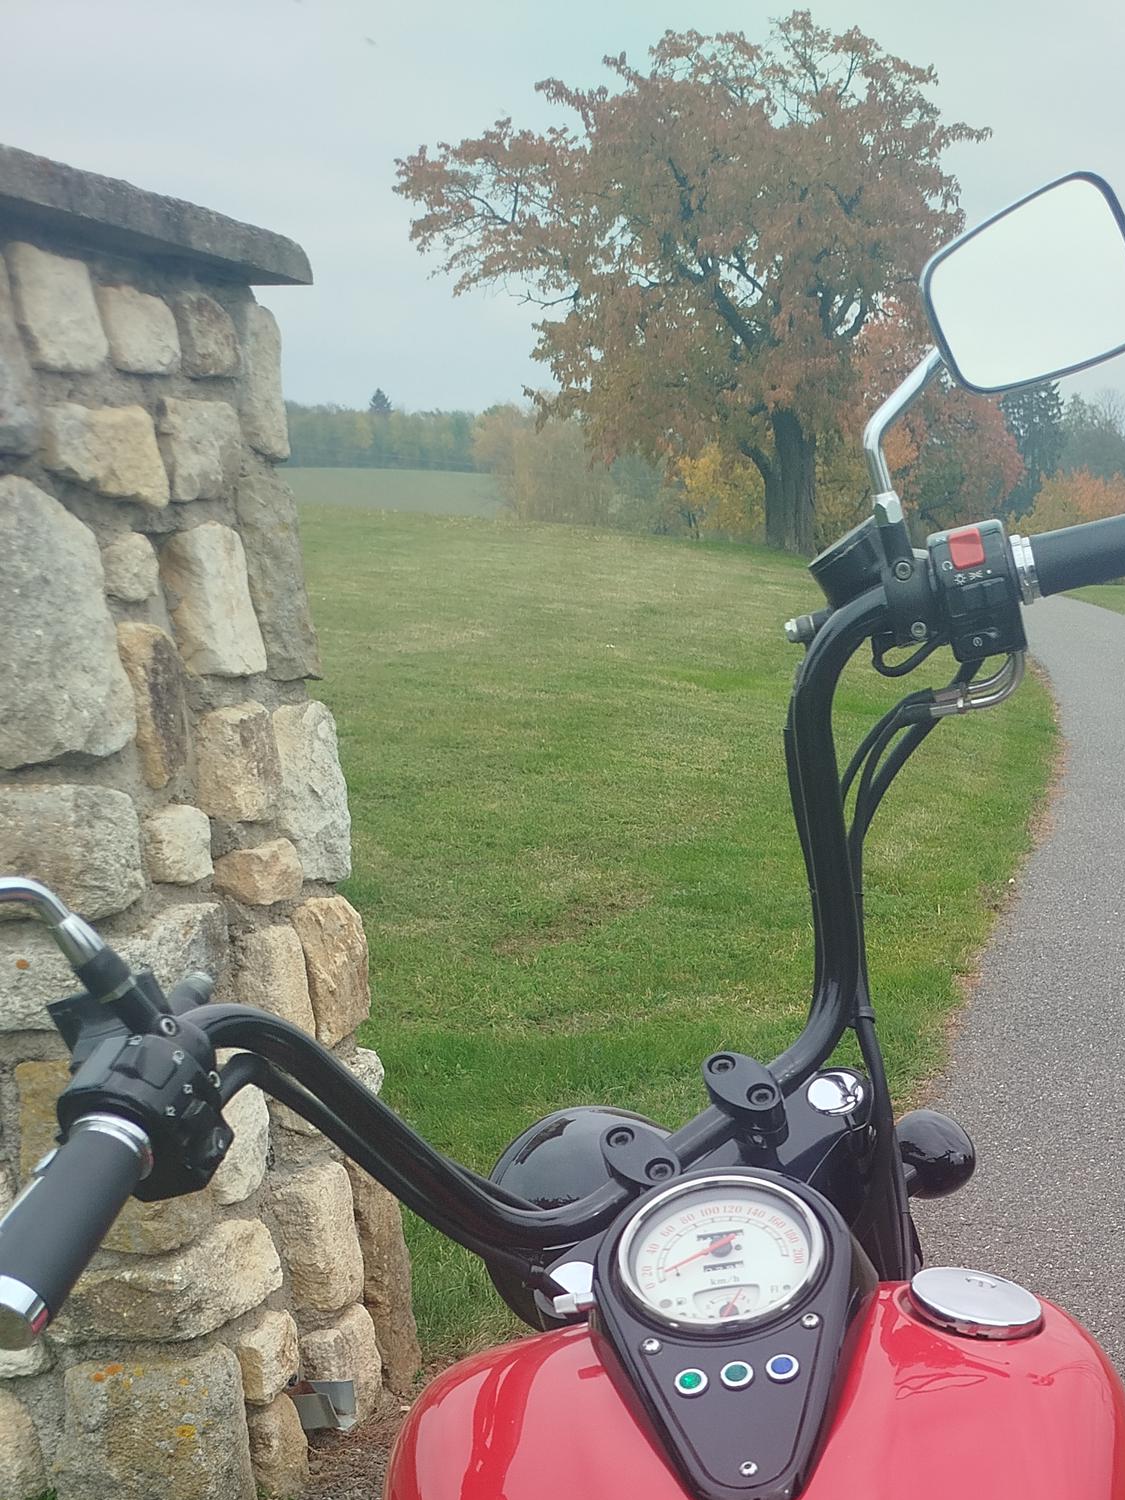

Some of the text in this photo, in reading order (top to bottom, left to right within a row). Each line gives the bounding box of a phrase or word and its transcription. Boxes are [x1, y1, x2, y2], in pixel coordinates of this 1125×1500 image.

[700, 1206, 720, 1217] 100
[722, 1205, 742, 1214] 120
[746, 1206, 766, 1218] 140
[680, 1213, 696, 1225] 80
[768, 1215, 787, 1229] 160
[660, 1225, 675, 1237] 60
[785, 1229, 800, 1244] 180
[646, 1243, 660, 1254] 40
[793, 1247, 805, 1264] 200
[641, 1265, 653, 1277] 20
